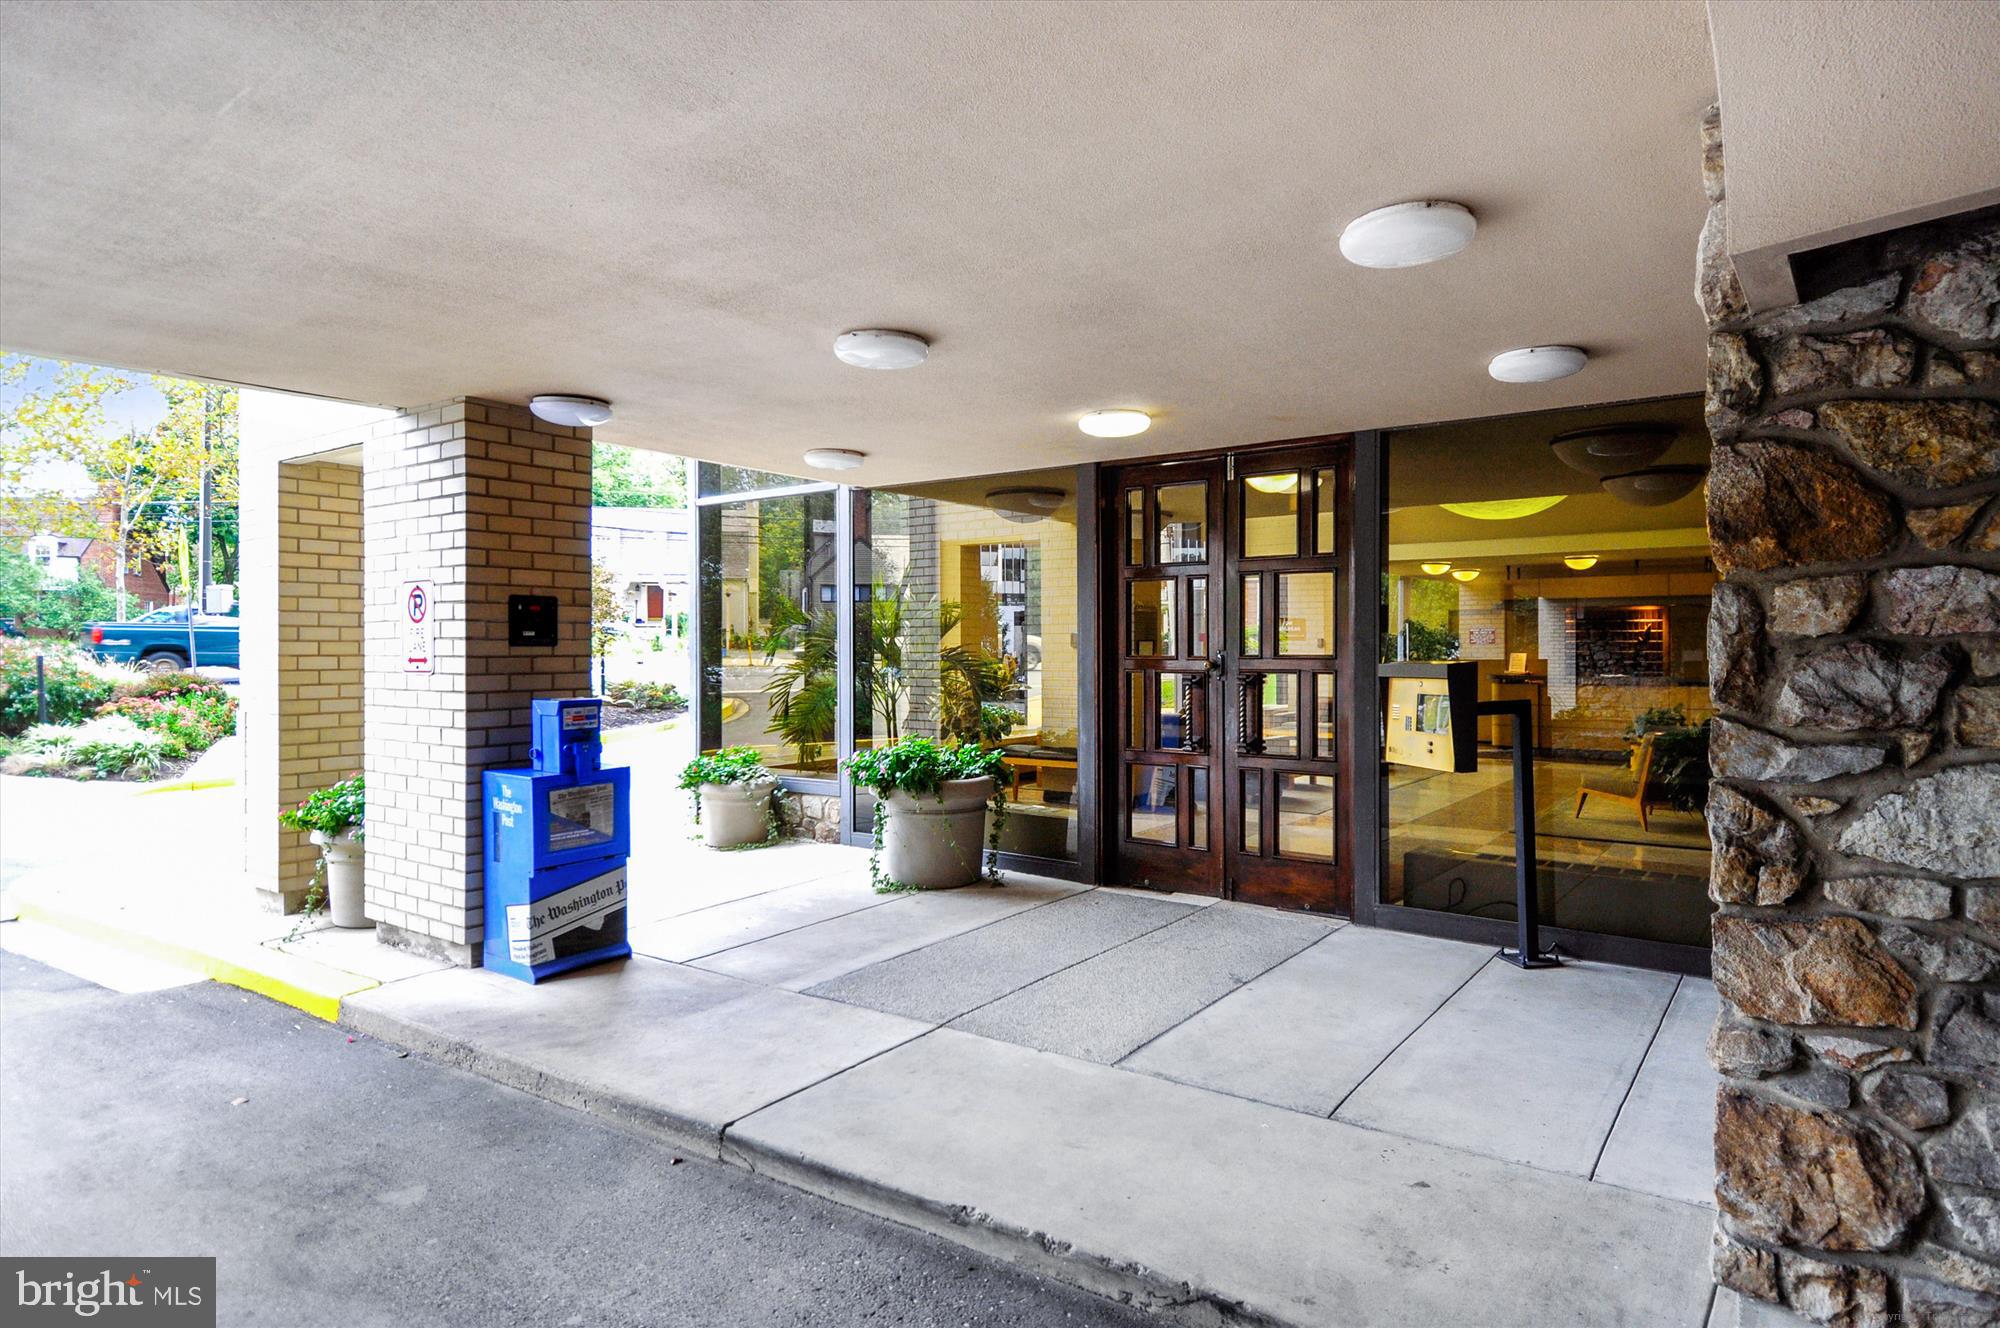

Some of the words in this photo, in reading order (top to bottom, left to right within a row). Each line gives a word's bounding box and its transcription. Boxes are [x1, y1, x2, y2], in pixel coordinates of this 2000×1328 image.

[501, 784, 512, 798] The
[492, 796, 523, 814] Washington
[502, 812, 514, 828] Post
[527, 914, 545, 929] The
[548, 886, 614, 920] Washington
[615, 879, 627, 895] P
